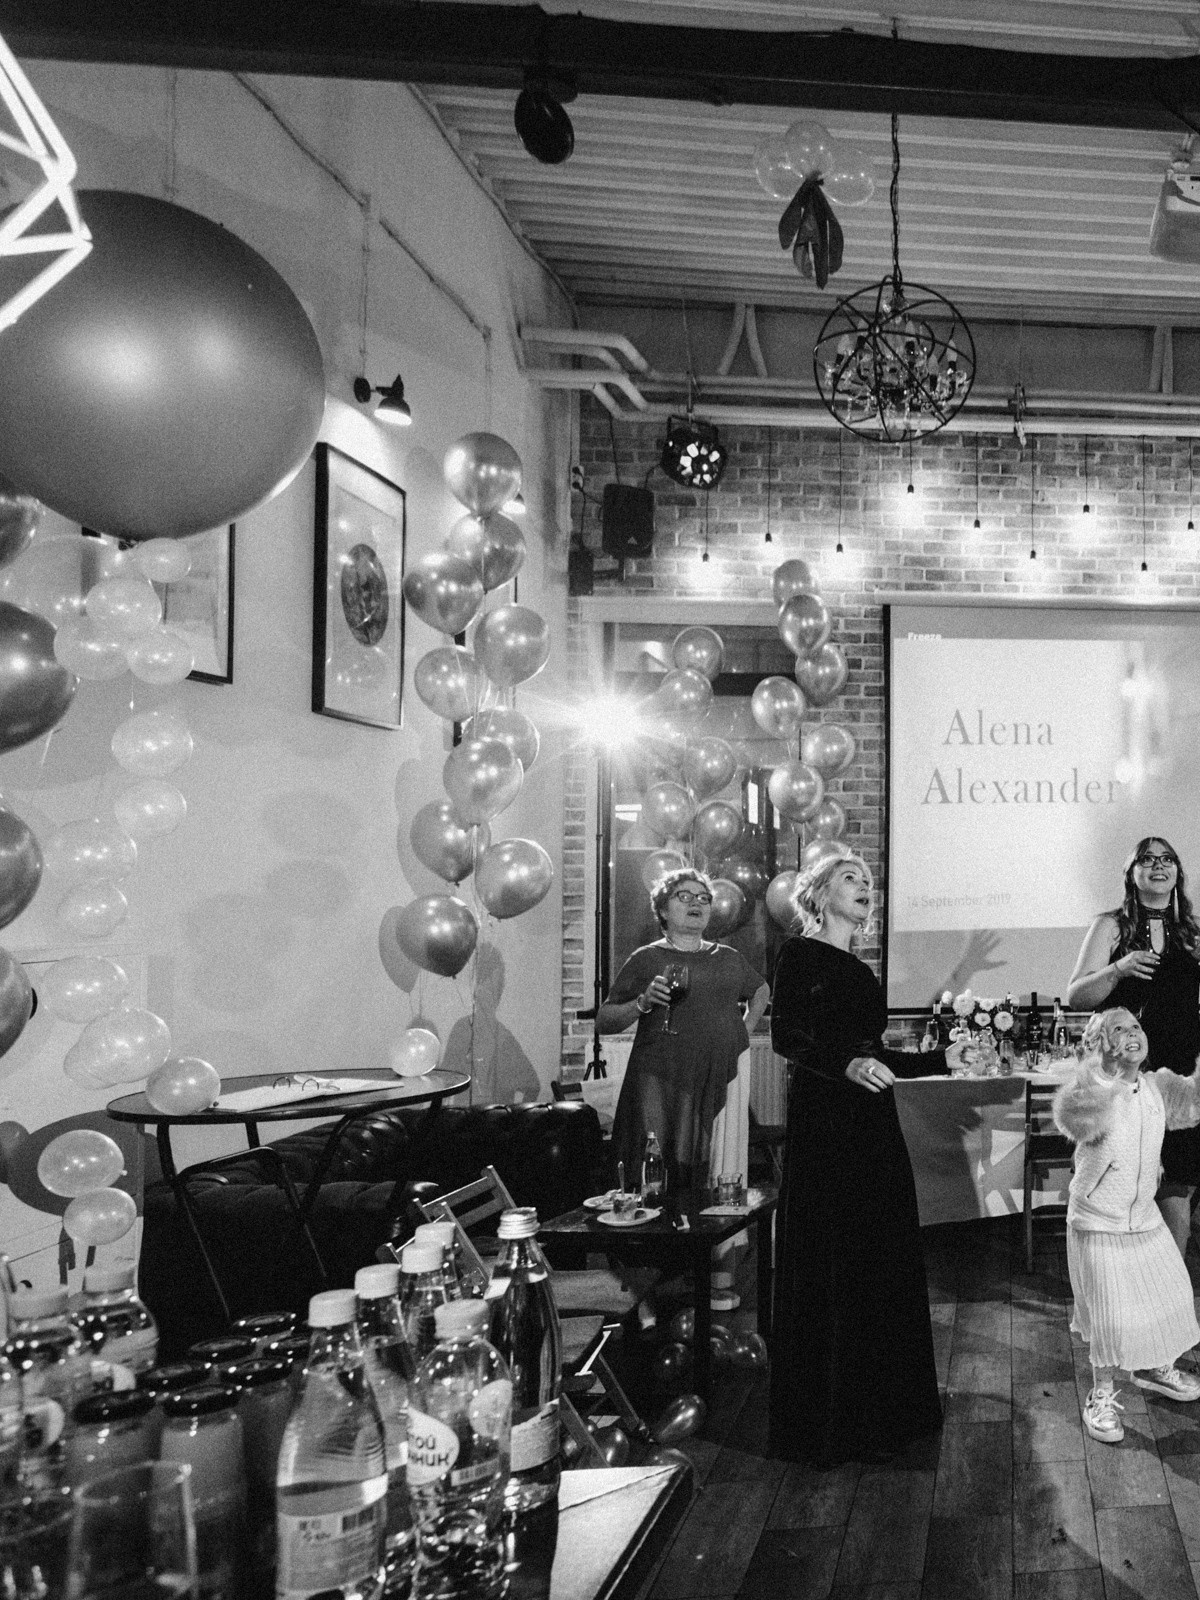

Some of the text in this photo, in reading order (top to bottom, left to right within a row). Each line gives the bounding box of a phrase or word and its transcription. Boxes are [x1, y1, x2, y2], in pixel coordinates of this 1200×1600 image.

[943, 709, 1053, 745] Alena
[921, 768, 1121, 804] Alexander
[920, 895, 982, 909] September
